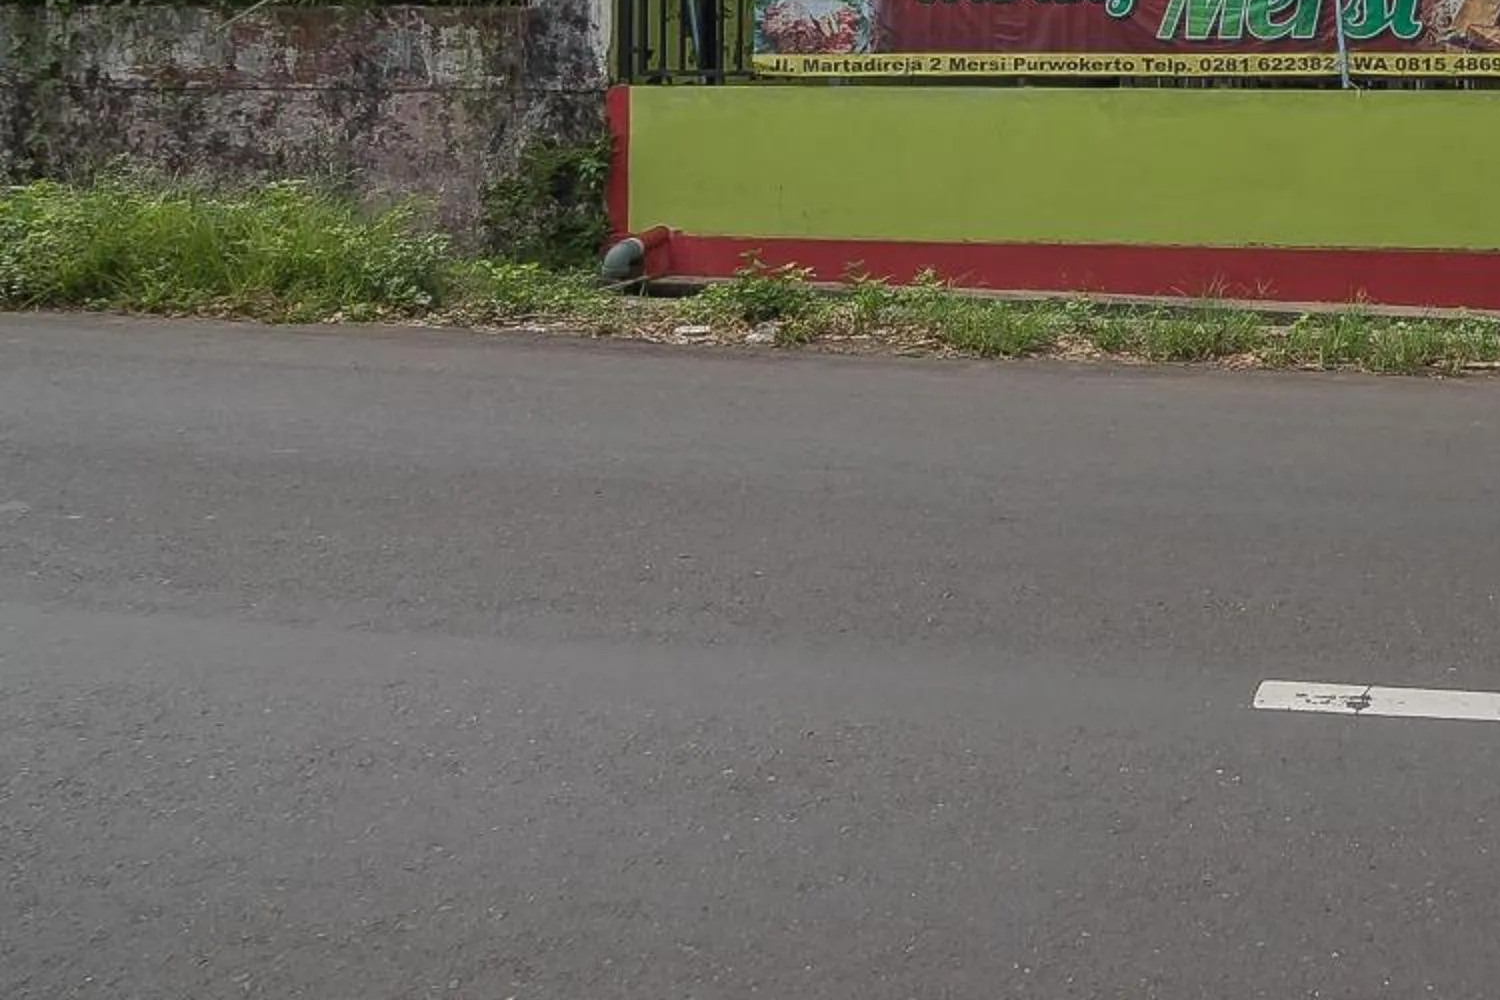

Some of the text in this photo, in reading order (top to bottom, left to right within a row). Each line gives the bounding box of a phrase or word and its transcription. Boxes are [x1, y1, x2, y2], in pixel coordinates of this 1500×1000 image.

[770, 58, 795, 73] Jl.
[803, 57, 922, 74] Martadireja
[930, 57, 942, 71] 2
[950, 57, 1006, 72] Mersi
[1014, 57, 1134, 72] Purwokerto
[1142, 57, 1193, 74] Telp.
[1199, 57, 1249, 72] 0281
[1353, 56, 1388, 71] WA
[1395, 56, 1446, 72] 0815
